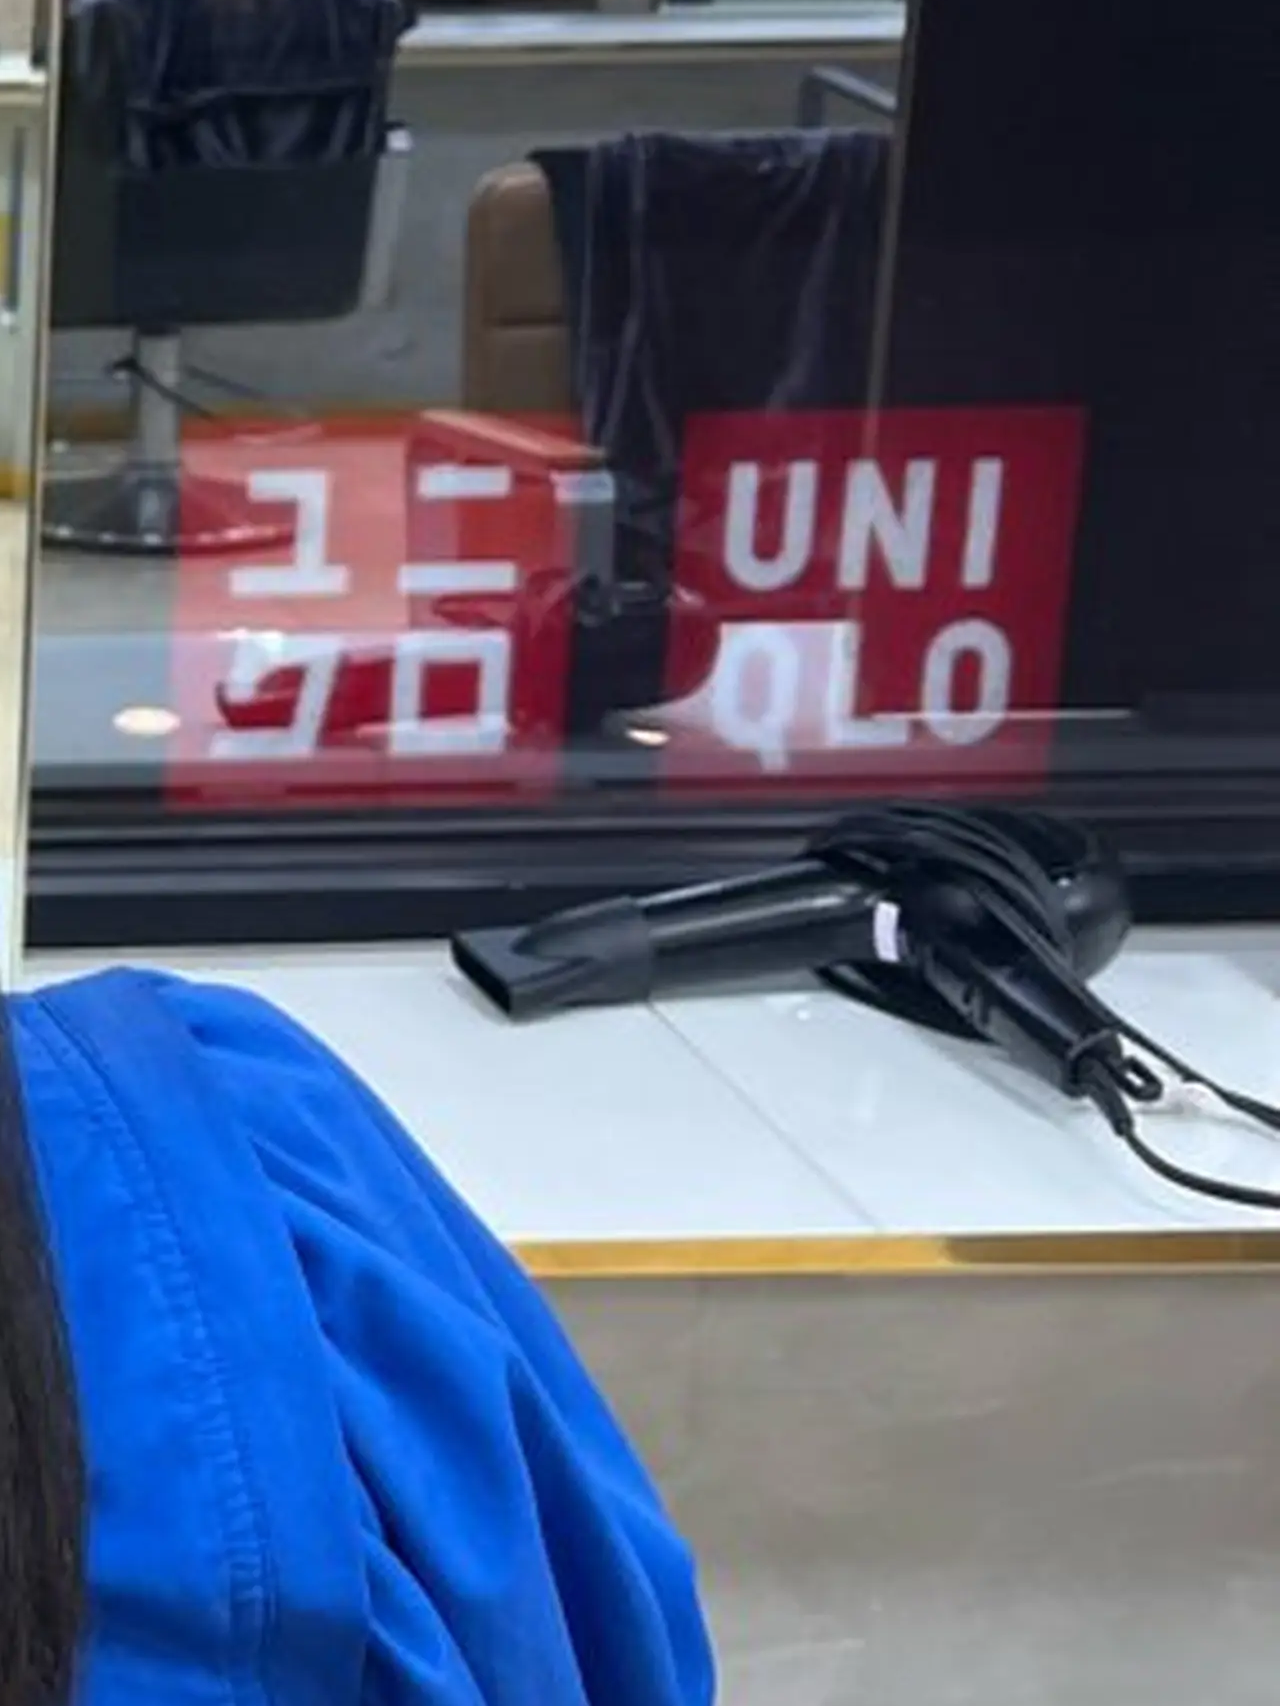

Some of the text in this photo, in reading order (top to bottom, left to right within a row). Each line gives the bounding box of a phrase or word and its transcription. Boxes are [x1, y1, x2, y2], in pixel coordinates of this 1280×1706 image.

[227, 465, 519, 597] ユニ
[723, 457, 1003, 592] UNI
[208, 629, 513, 759] クロ
[712, 618, 1013, 773] QLO
